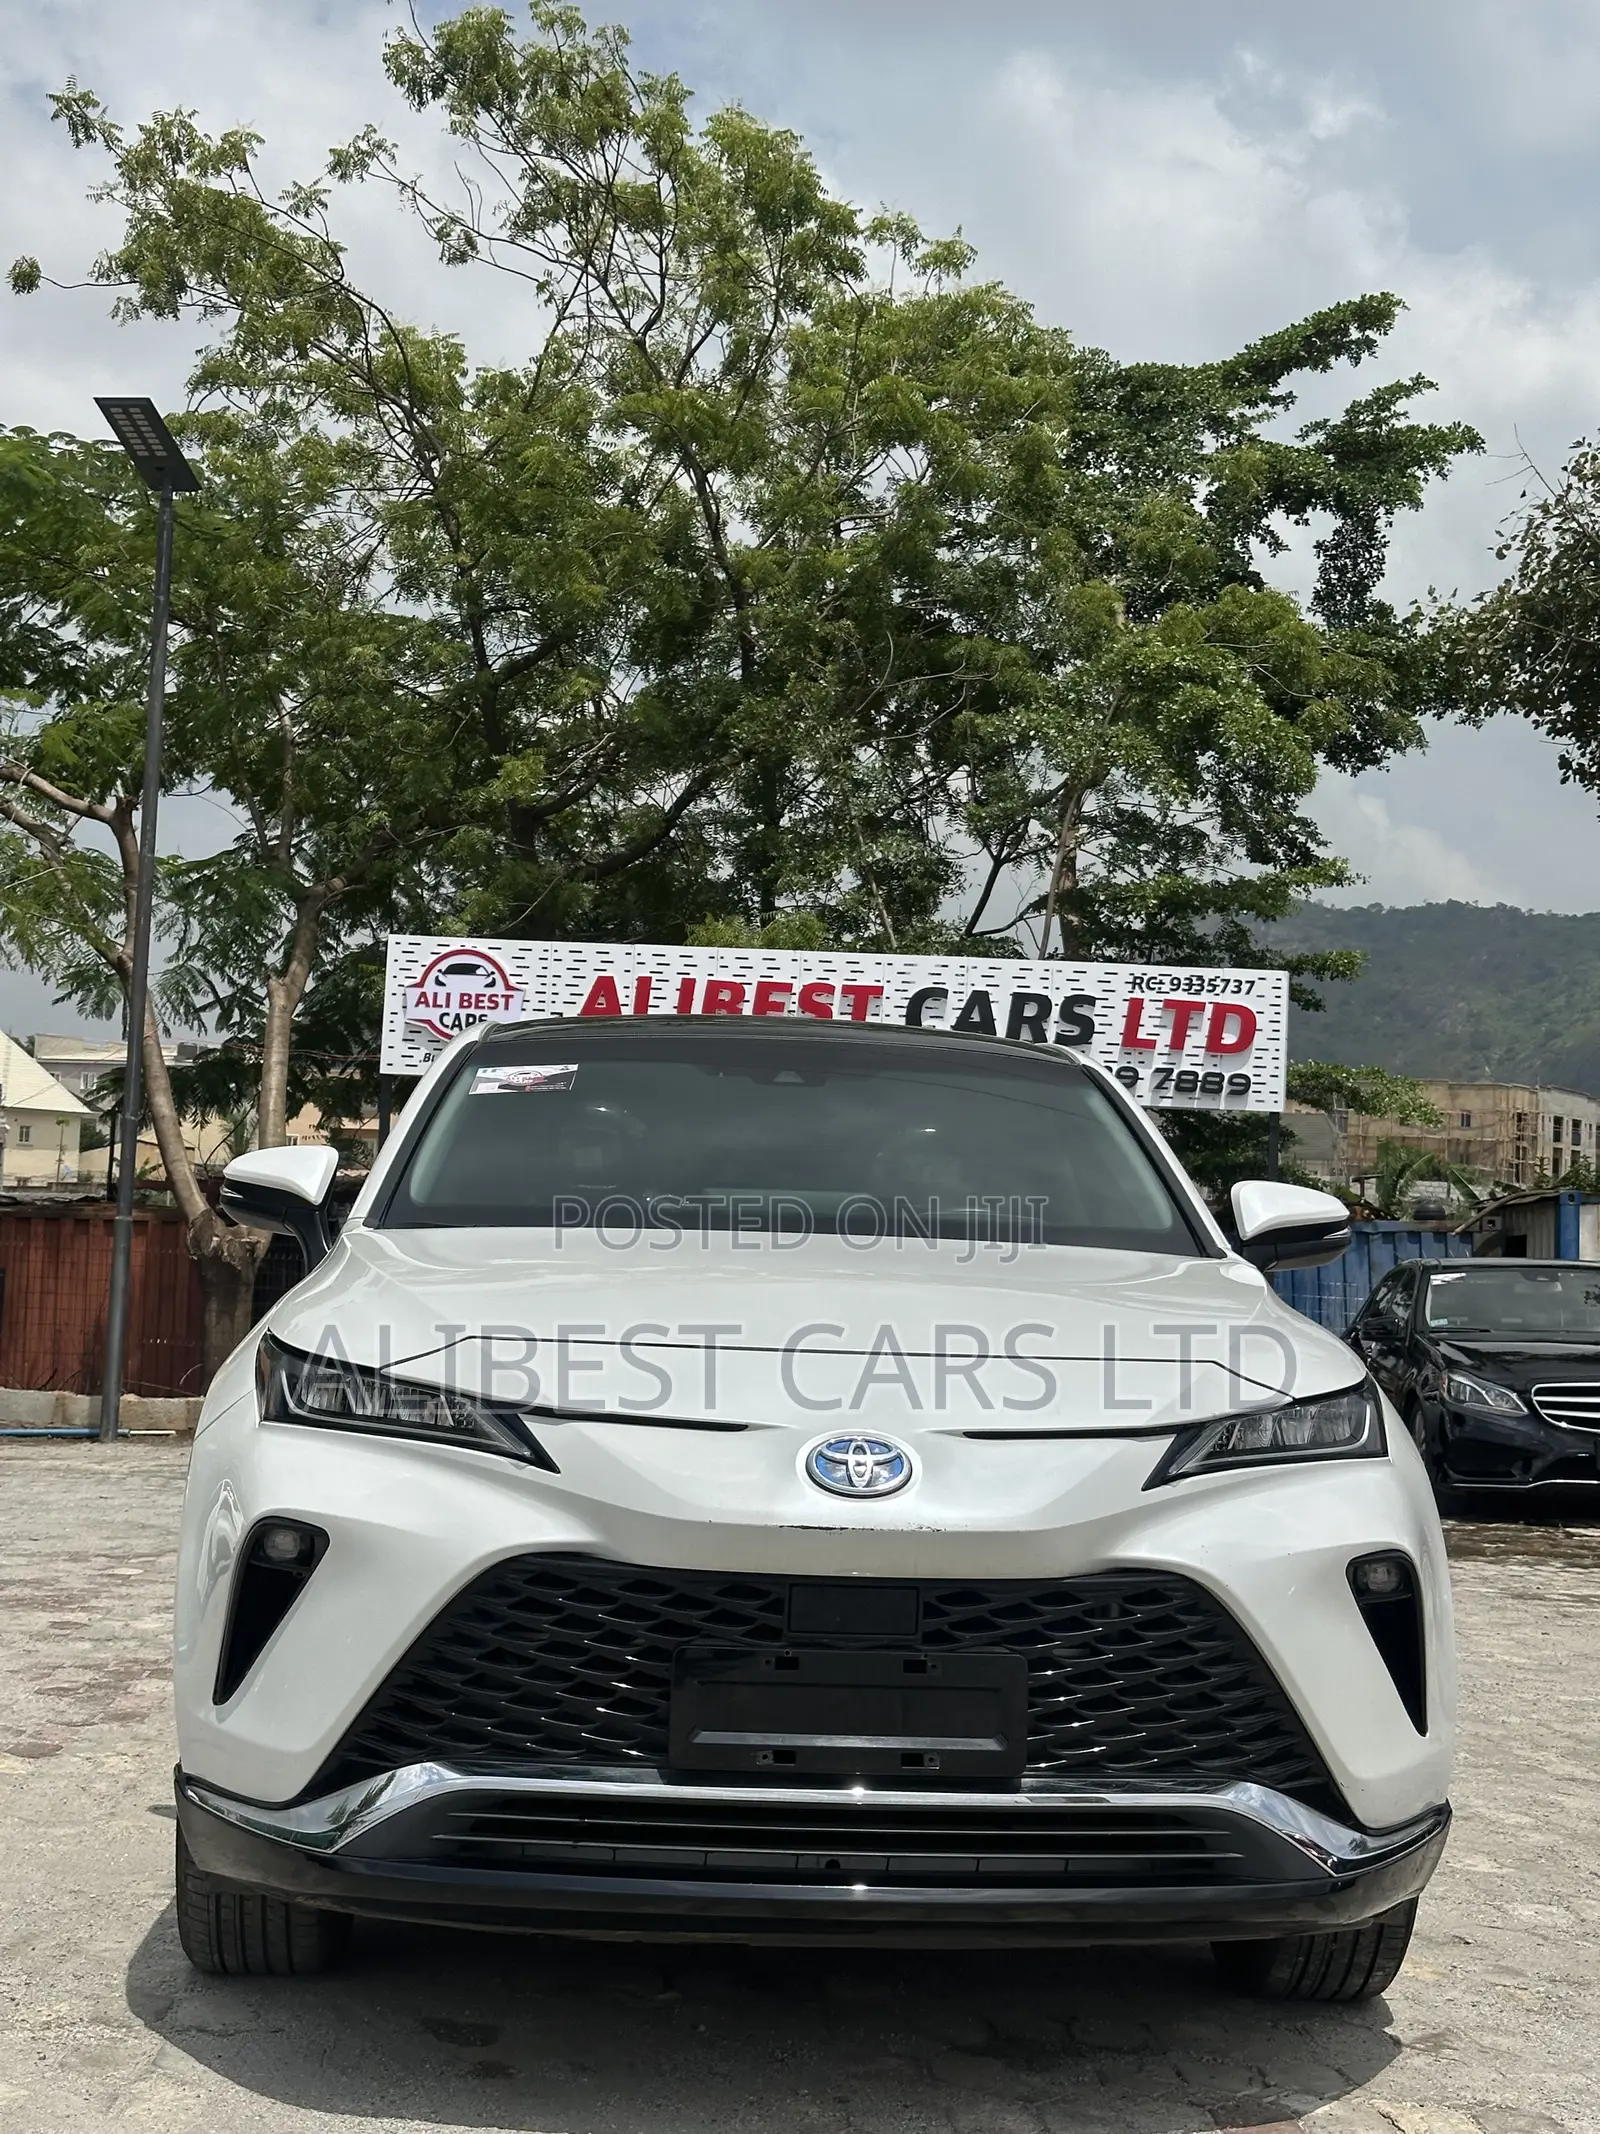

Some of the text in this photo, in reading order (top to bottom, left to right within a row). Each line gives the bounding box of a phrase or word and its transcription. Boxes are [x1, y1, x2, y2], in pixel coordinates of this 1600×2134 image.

[1168, 976, 1256, 996] 9335737
[414, 991, 515, 1011] ALI BEST
[905, 986, 1097, 1047] CARS
[1121, 997, 1257, 1055] LTD
[1153, 1067, 1251, 1096] 7889
